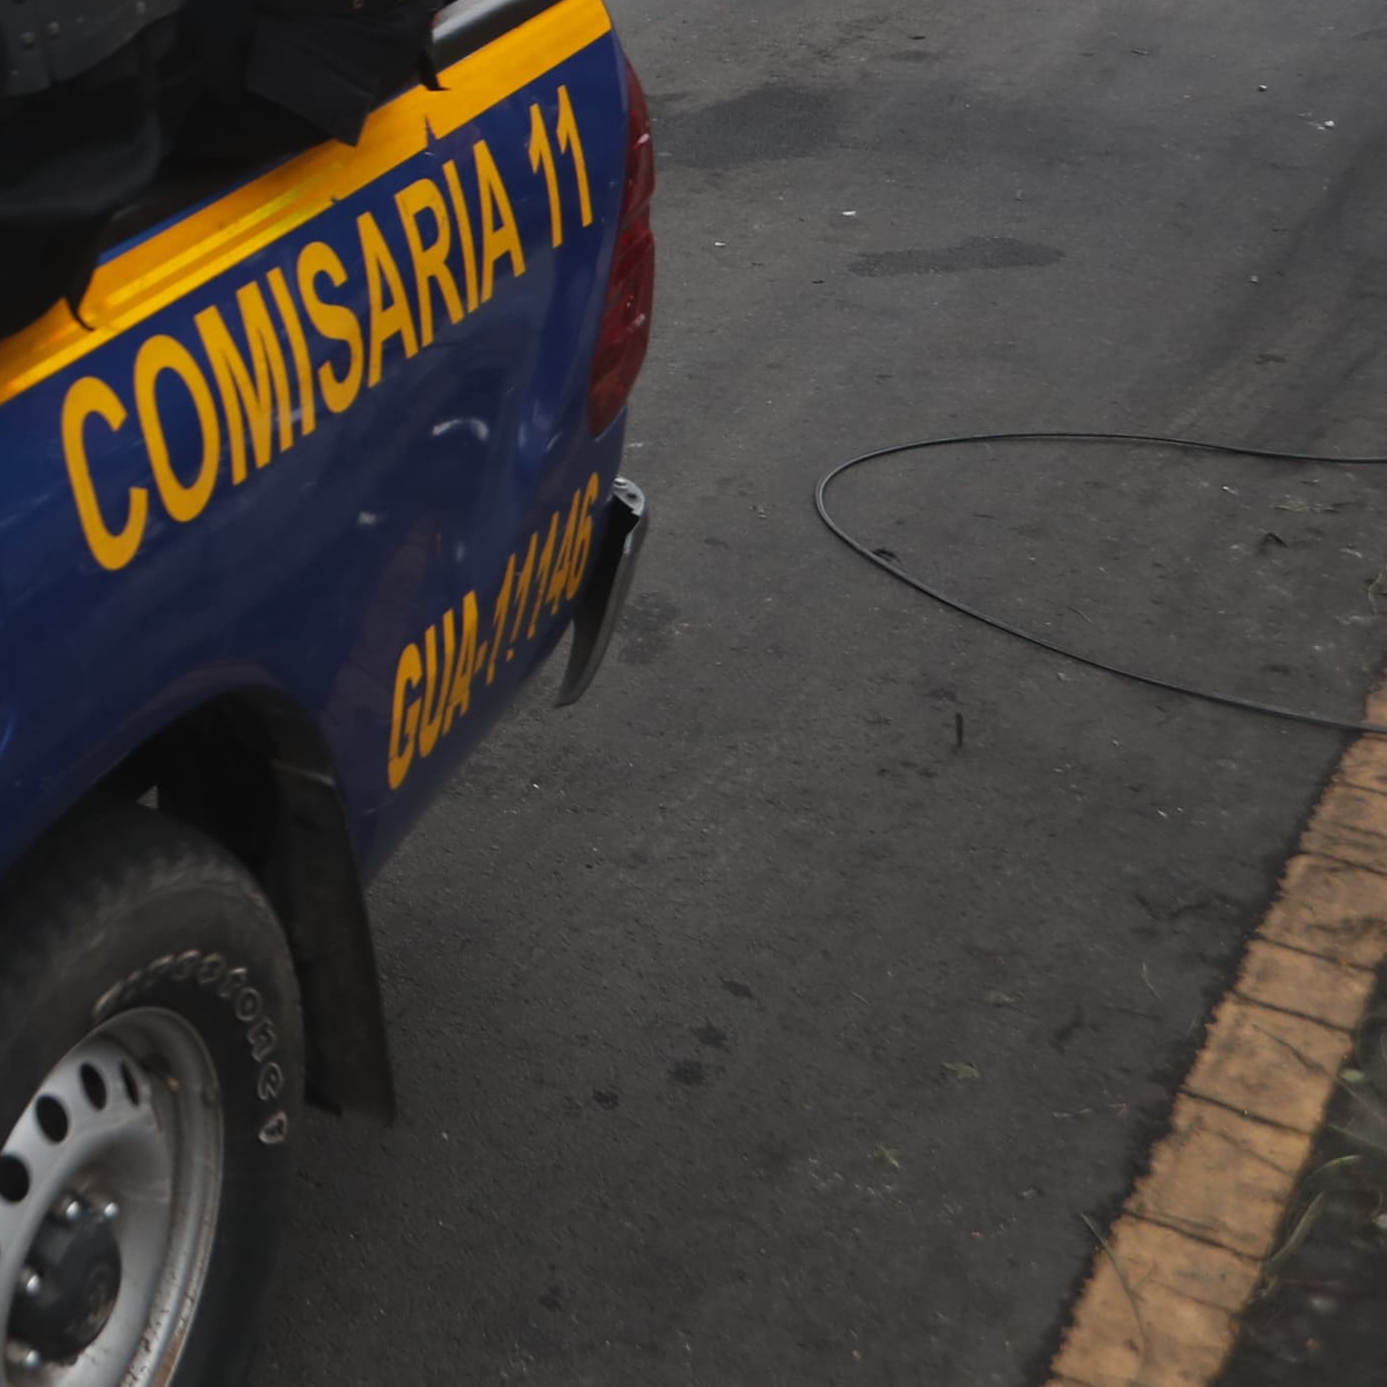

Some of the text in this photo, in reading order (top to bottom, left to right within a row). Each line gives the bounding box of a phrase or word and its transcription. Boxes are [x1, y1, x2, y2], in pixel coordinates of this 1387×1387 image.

[60, 85, 593, 570] COMISARIA 11
[387, 472, 601, 790] GUA-11146
